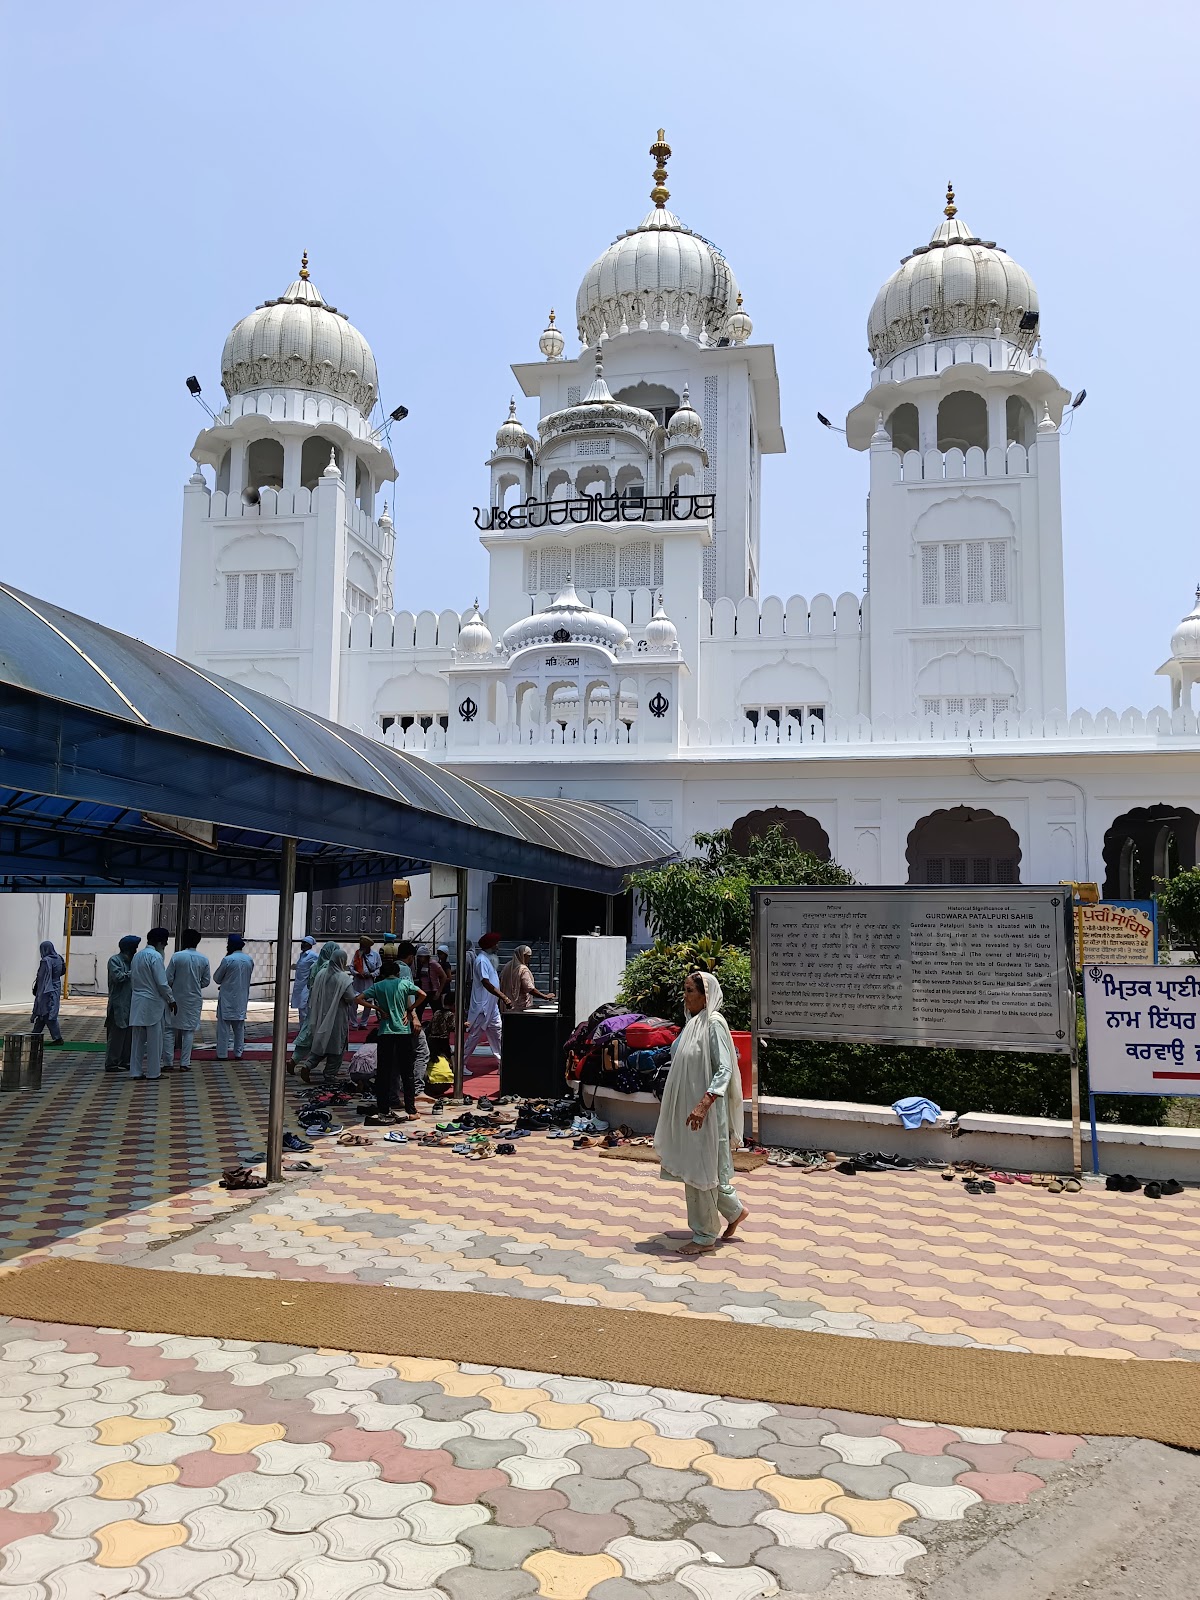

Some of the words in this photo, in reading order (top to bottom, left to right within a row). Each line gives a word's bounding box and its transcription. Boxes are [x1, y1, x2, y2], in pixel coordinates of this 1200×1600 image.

[1083, 907, 1110, 923] ਪੁਰੀ
[1111, 912, 1152, 939] ਸਾਹਿਬ
[1102, 974, 1152, 1001] ਮ੍ਰਿਤਕ
[1105, 1011, 1141, 1028] ਨਾਮ
[1148, 1005, 1196, 1029] ਇੱਧਰ
